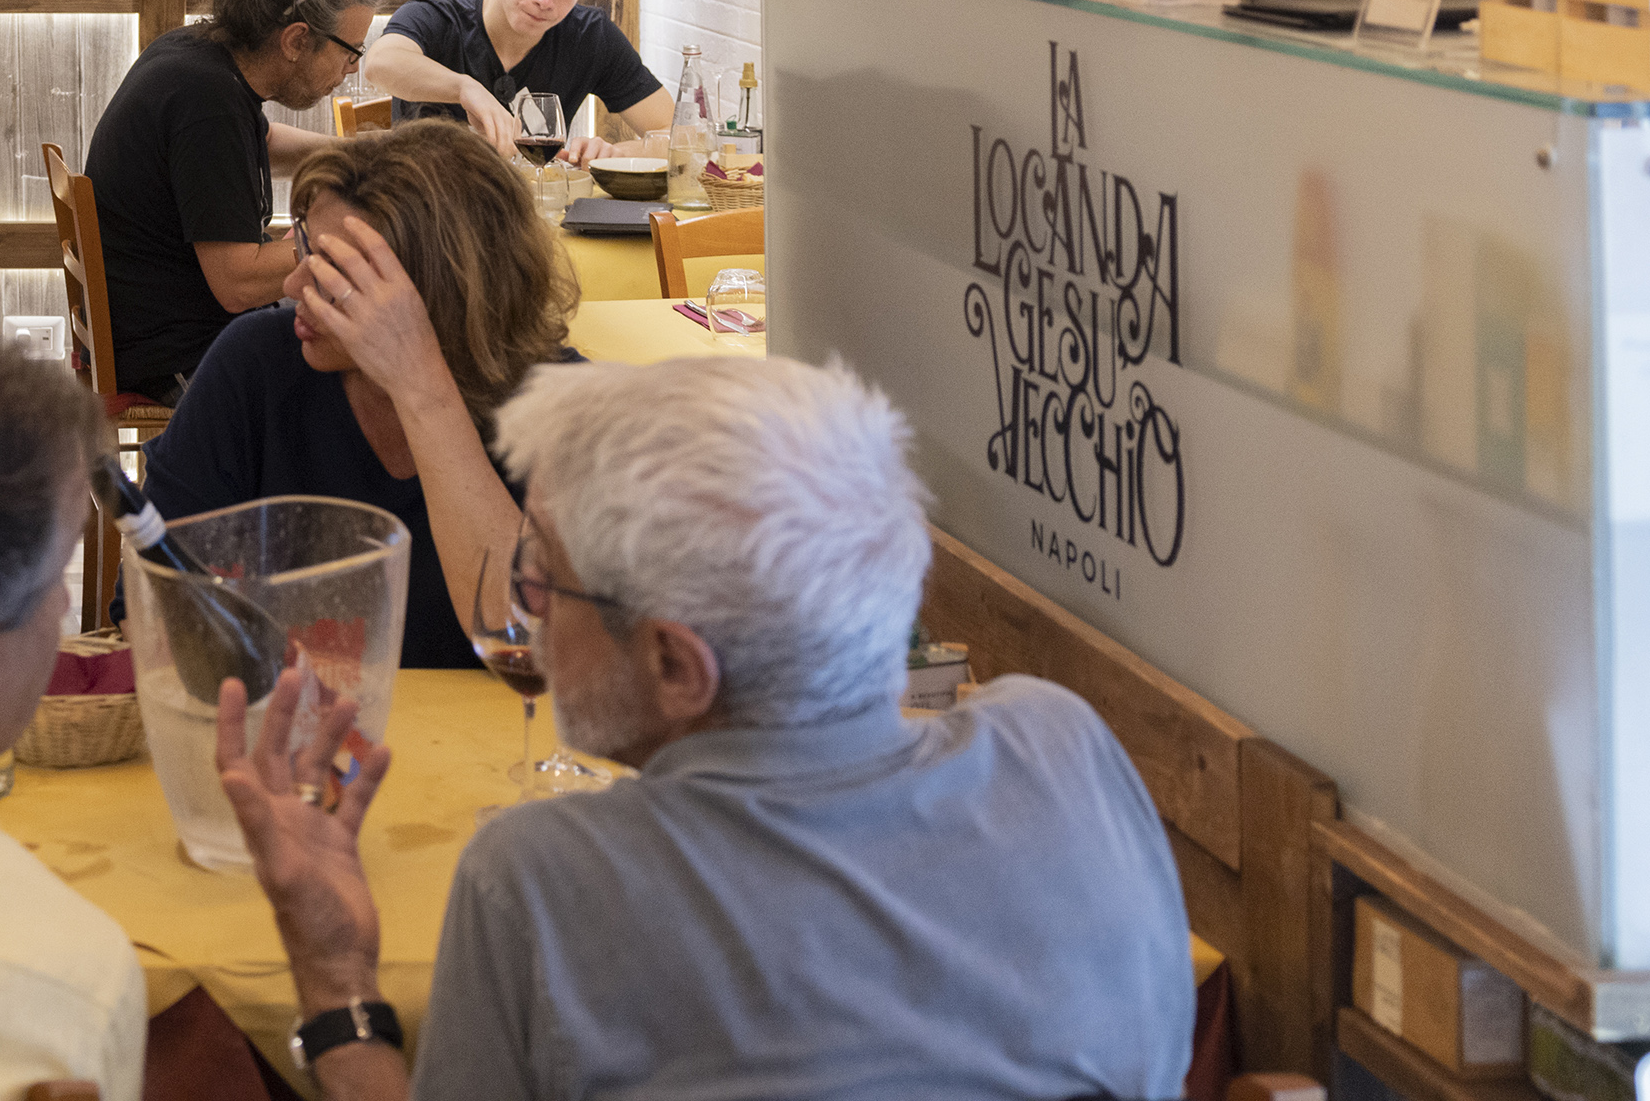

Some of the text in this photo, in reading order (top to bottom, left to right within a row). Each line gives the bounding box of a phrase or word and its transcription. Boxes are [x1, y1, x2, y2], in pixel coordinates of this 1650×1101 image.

[1049, 39, 1088, 160] LA
[971, 123, 1183, 367] LOCANDA
[964, 282, 1186, 568] VECCHIO
[1030, 517, 1122, 601] NAPOLI
